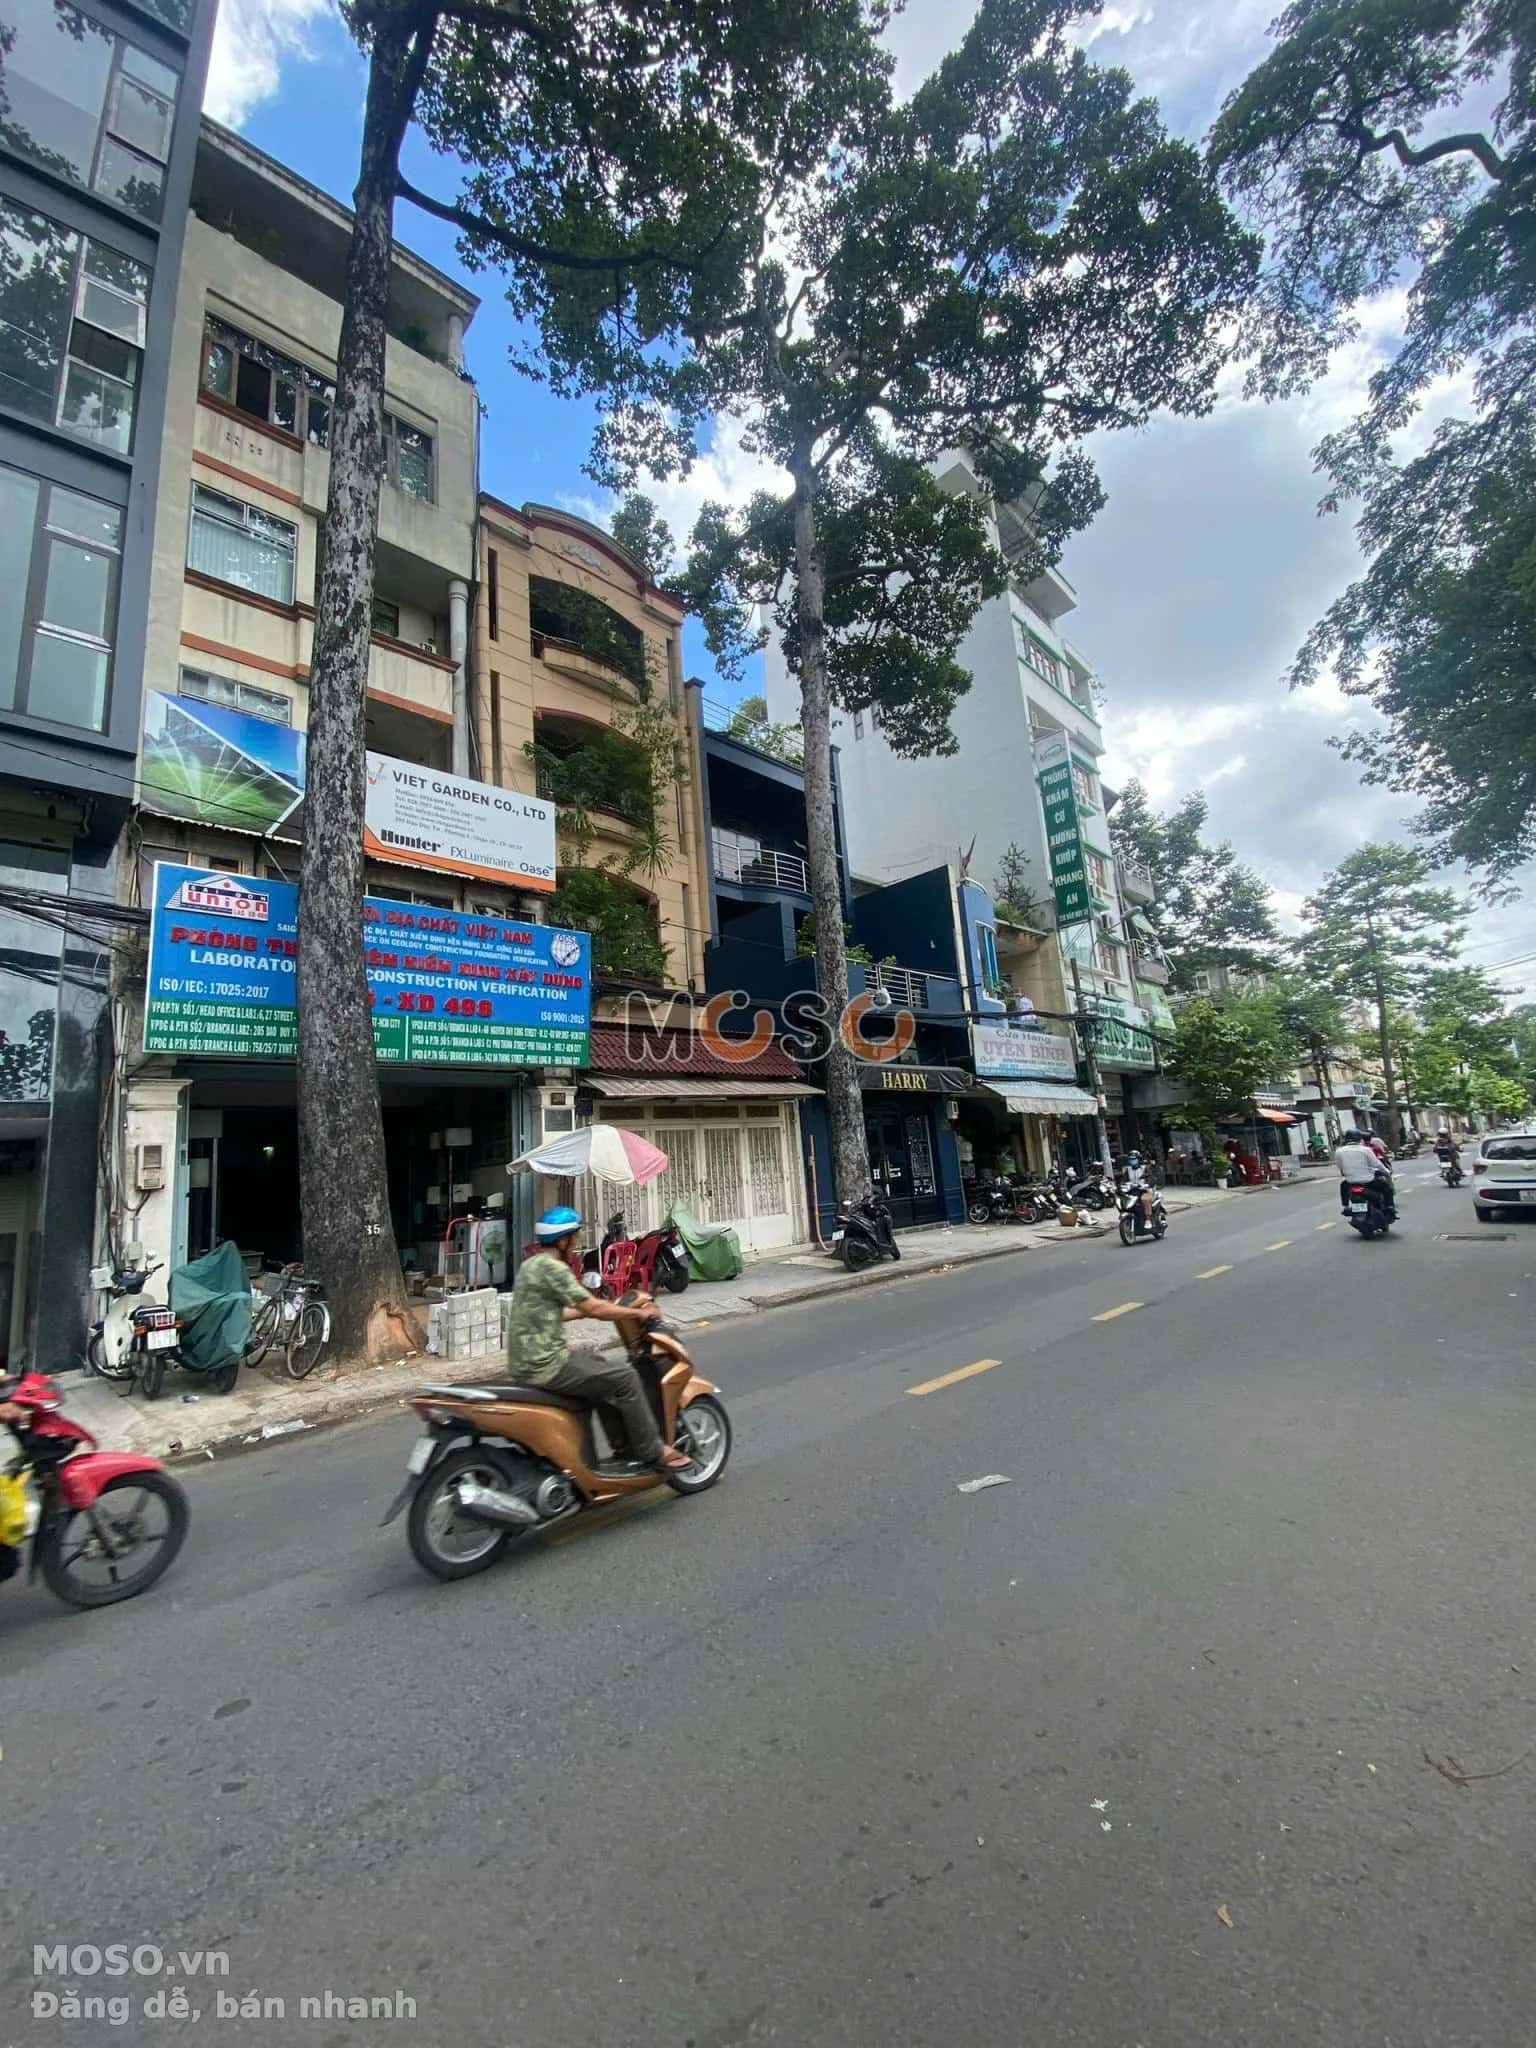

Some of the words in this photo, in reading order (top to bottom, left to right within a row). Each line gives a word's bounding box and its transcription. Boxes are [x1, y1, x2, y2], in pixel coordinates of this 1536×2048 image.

[392, 770, 428, 789] VIET
[432, 782, 490, 806] GARDEN
[494, 798, 520, 816] CO.,
[524, 806, 546, 820] LTD
[381, 829, 441, 852] Hunter
[450, 846, 514, 869] FXLuminaire
[520, 862, 550, 876] Oase
[1055, 869, 1084, 887] KHANG
[1066, 893, 1078, 906] AN
[502, 929, 532, 944] NAM
[392, 940, 423, 949] GEOLOGY
[425, 944, 472, 956] CONSTRUCTION
[366, 968, 478, 992] CONSTRUCTION
[481, 981, 568, 1001] VERIFICATION
[398, 992, 434, 1012] XD
[881, 1071, 928, 1089] HARRY
